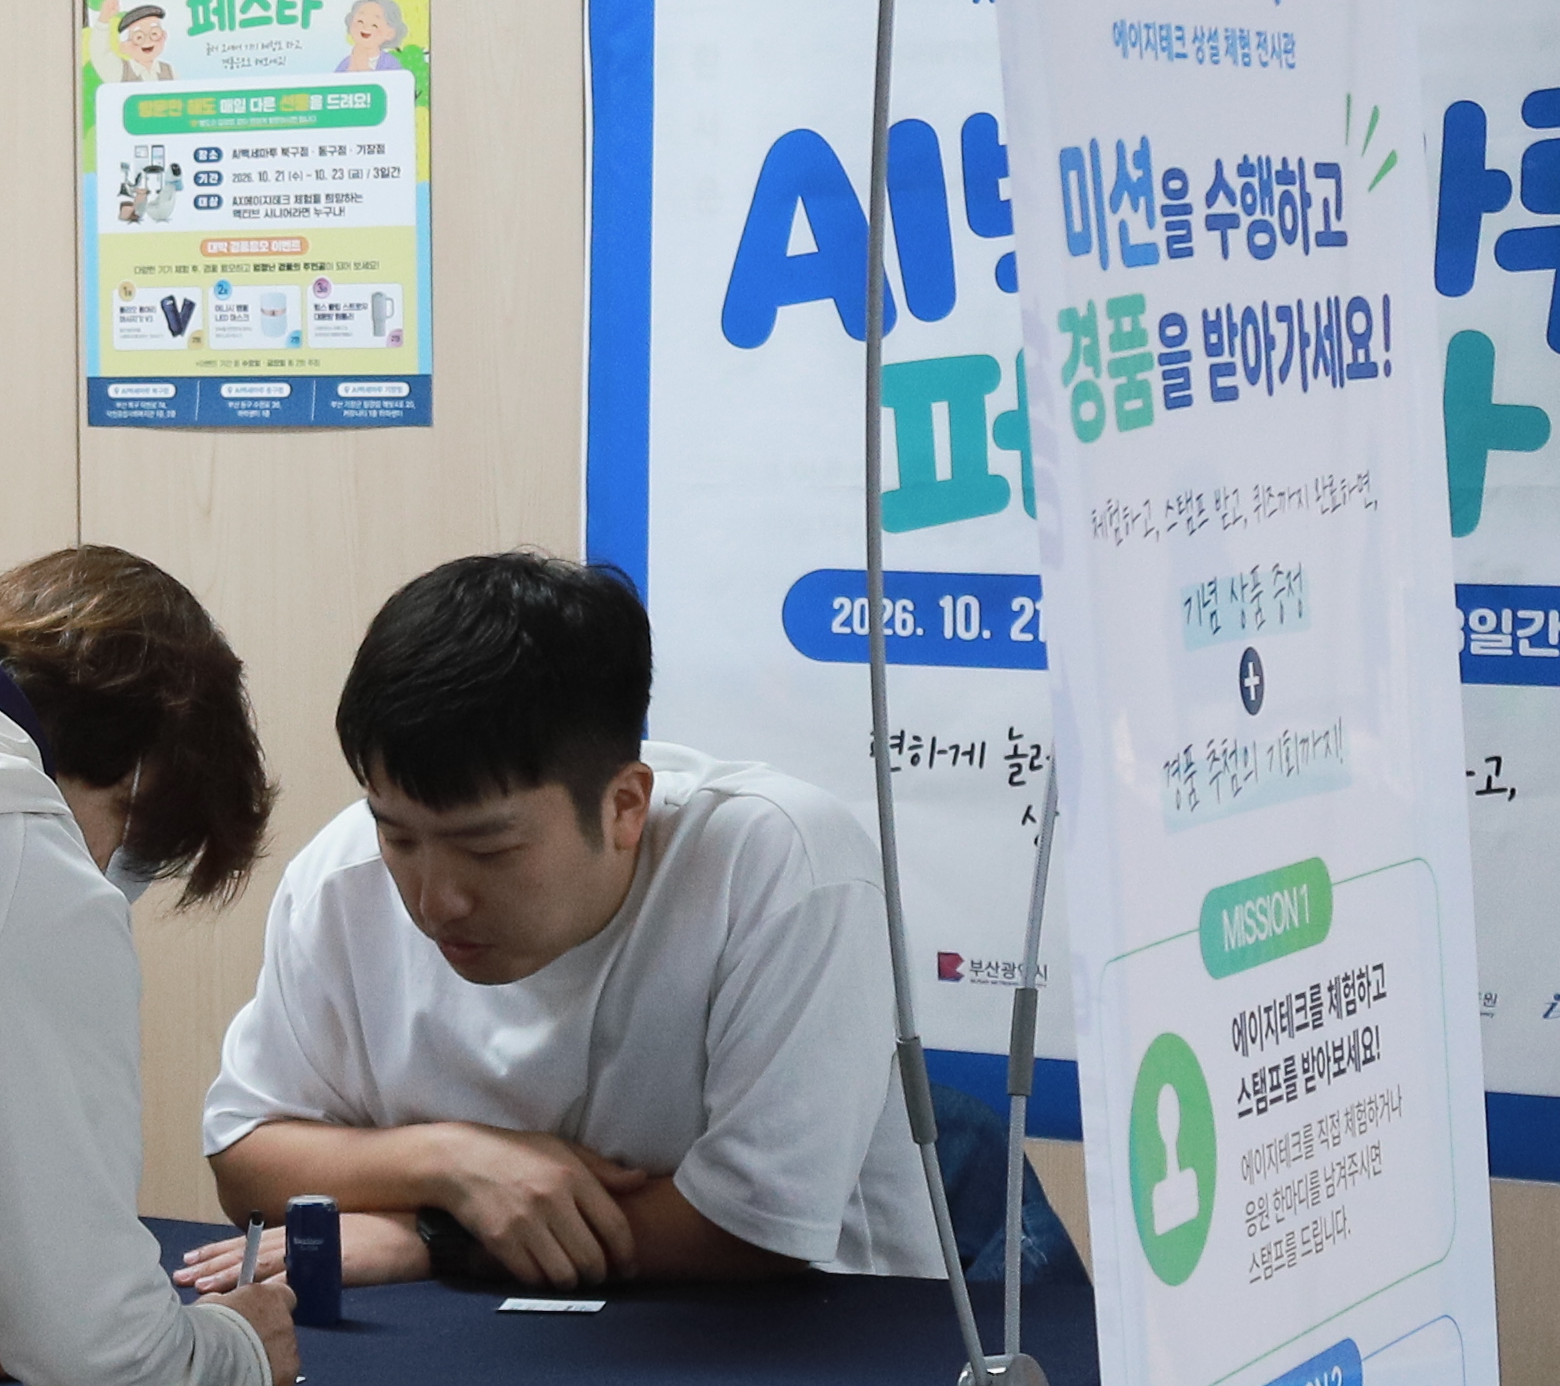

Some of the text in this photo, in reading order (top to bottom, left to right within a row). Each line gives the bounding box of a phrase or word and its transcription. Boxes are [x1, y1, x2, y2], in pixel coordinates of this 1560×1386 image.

[250, 96, 276, 112] 다른
[326, 93, 371, 109] 드려요!
[198, 173, 219, 184] 기간
[259, 171, 270, 182] 10.
[275, 170, 285, 182] 21
[315, 169, 327, 180] 10.
[332, 168, 344, 180] 23
[373, 166, 401, 179] 3일간
[1059, 134, 1348, 271] 미션을 수행하고
[1058, 292, 1393, 443] 경품을 받아가세요!
[1091, 469, 1378, 547] 체험하고, 스탬프 받고, 퀴즈까지 완료하면,
[941, 594, 991, 642] 10.
[1184, 561, 1303, 635] 기념 상품 증정
[1163, 716, 1344, 812] 경품 추첨의 기회까지!
[1222, 883, 1311, 953] MISSION 1
[1231, 962, 1387, 1057] 에이지테크를 체험하고
[1237, 1025, 1382, 1119] 스탬프를 받아보세요!
